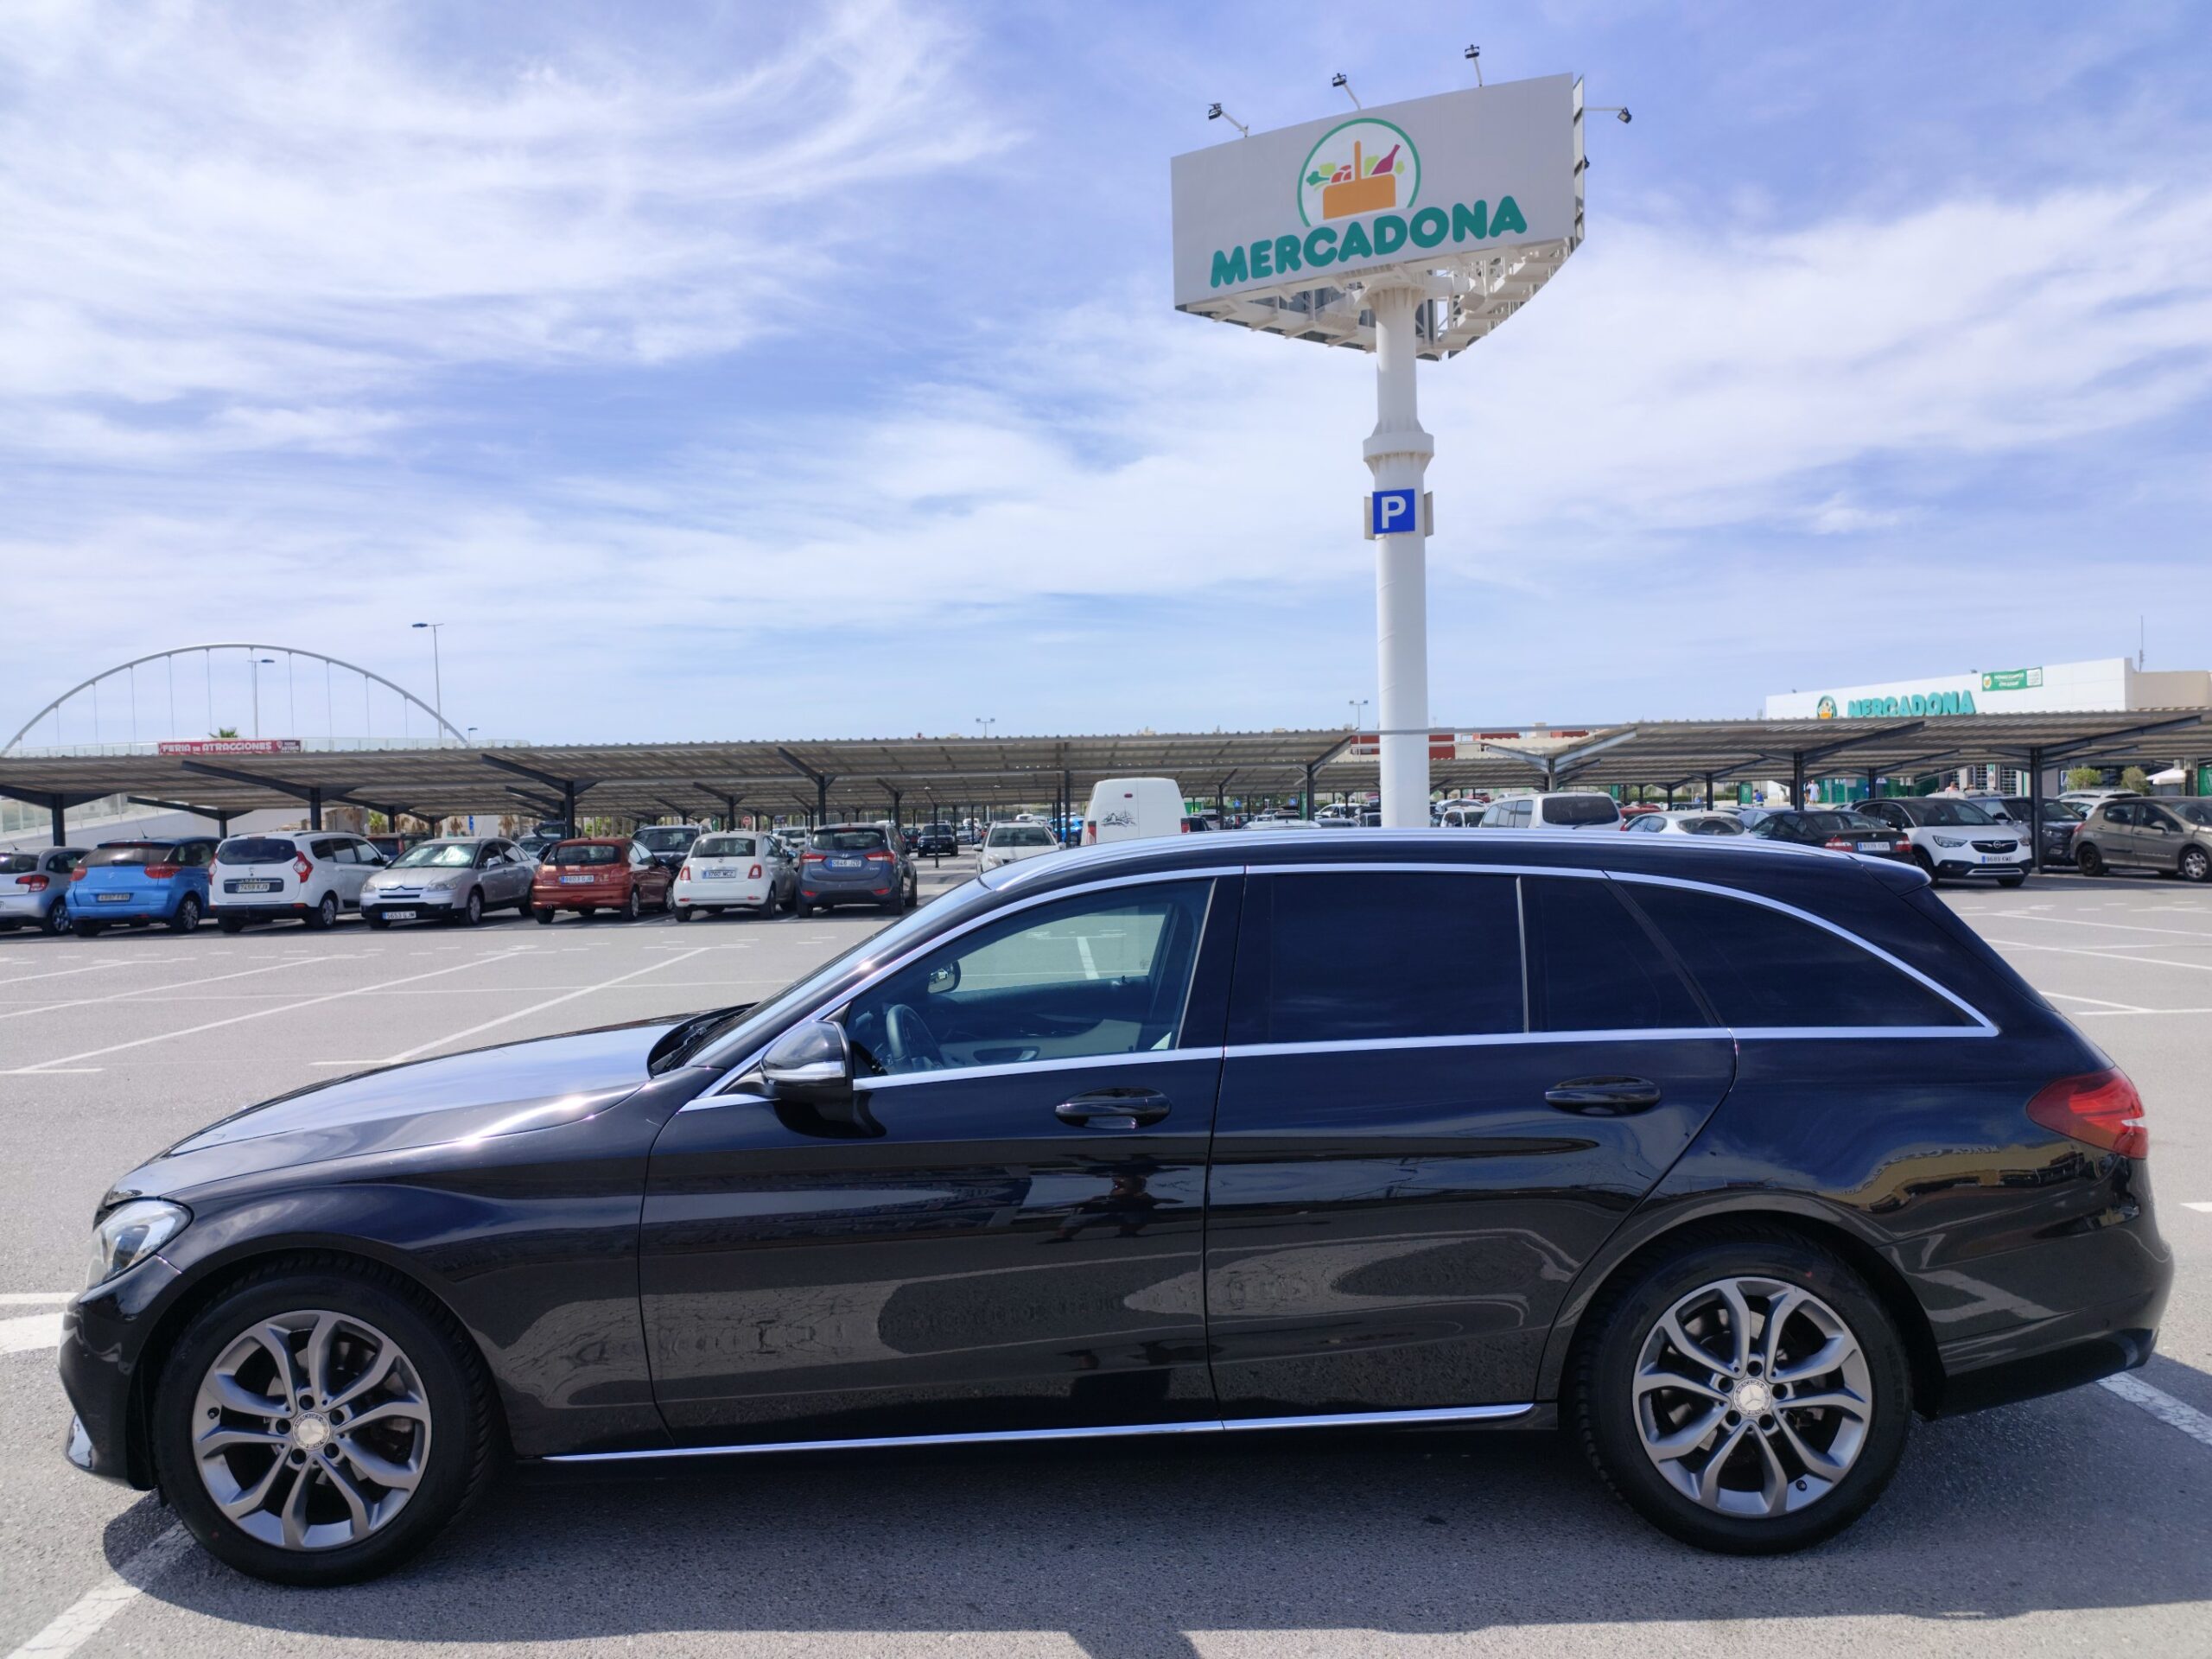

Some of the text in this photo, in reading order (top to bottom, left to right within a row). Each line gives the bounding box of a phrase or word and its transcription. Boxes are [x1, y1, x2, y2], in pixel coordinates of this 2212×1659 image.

[1211, 195, 1527, 288] MERCADONA
[1382, 495, 1406, 529] P
[1847, 690, 1976, 718] MERCADONA
[162, 743, 191, 753] FERIA
[202, 741, 272, 752] ATRACCIONES
